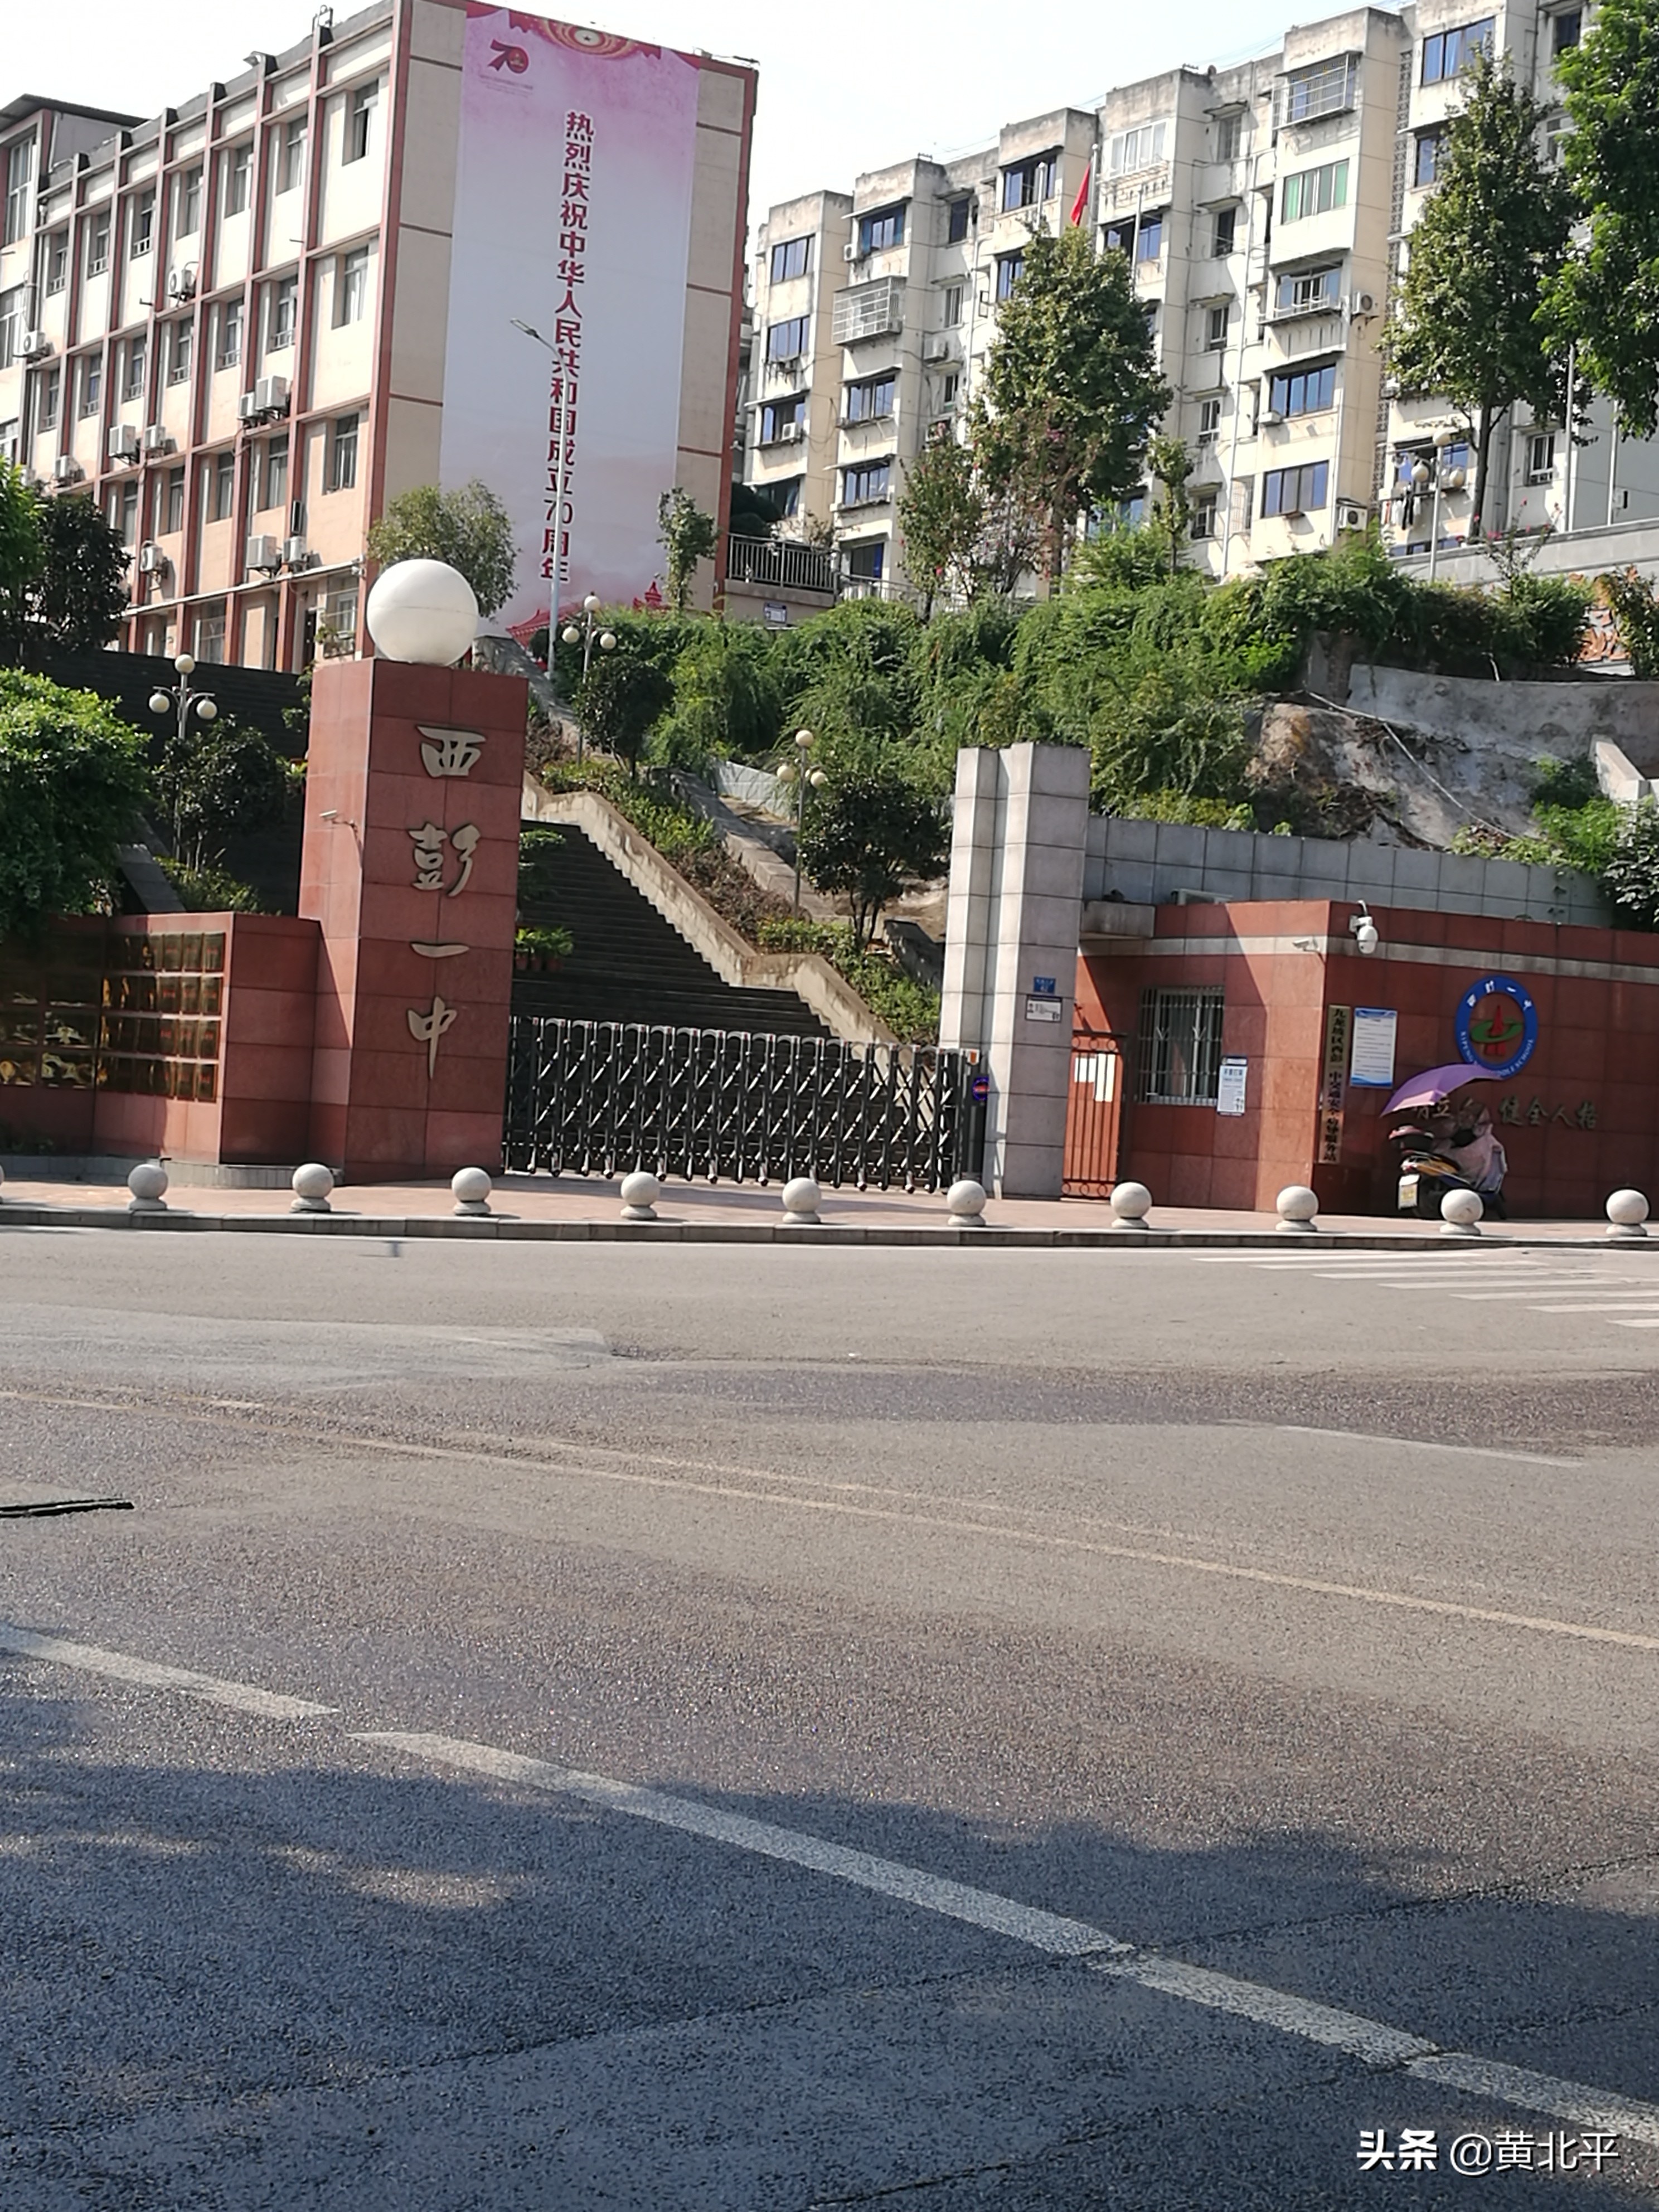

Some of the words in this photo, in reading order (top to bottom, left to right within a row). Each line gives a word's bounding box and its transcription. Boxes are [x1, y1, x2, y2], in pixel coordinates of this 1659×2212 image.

[540, 111, 594, 582] 热烈庆祝中华人民共和国成立70周年
[407, 725, 487, 1080] 西彭一中
